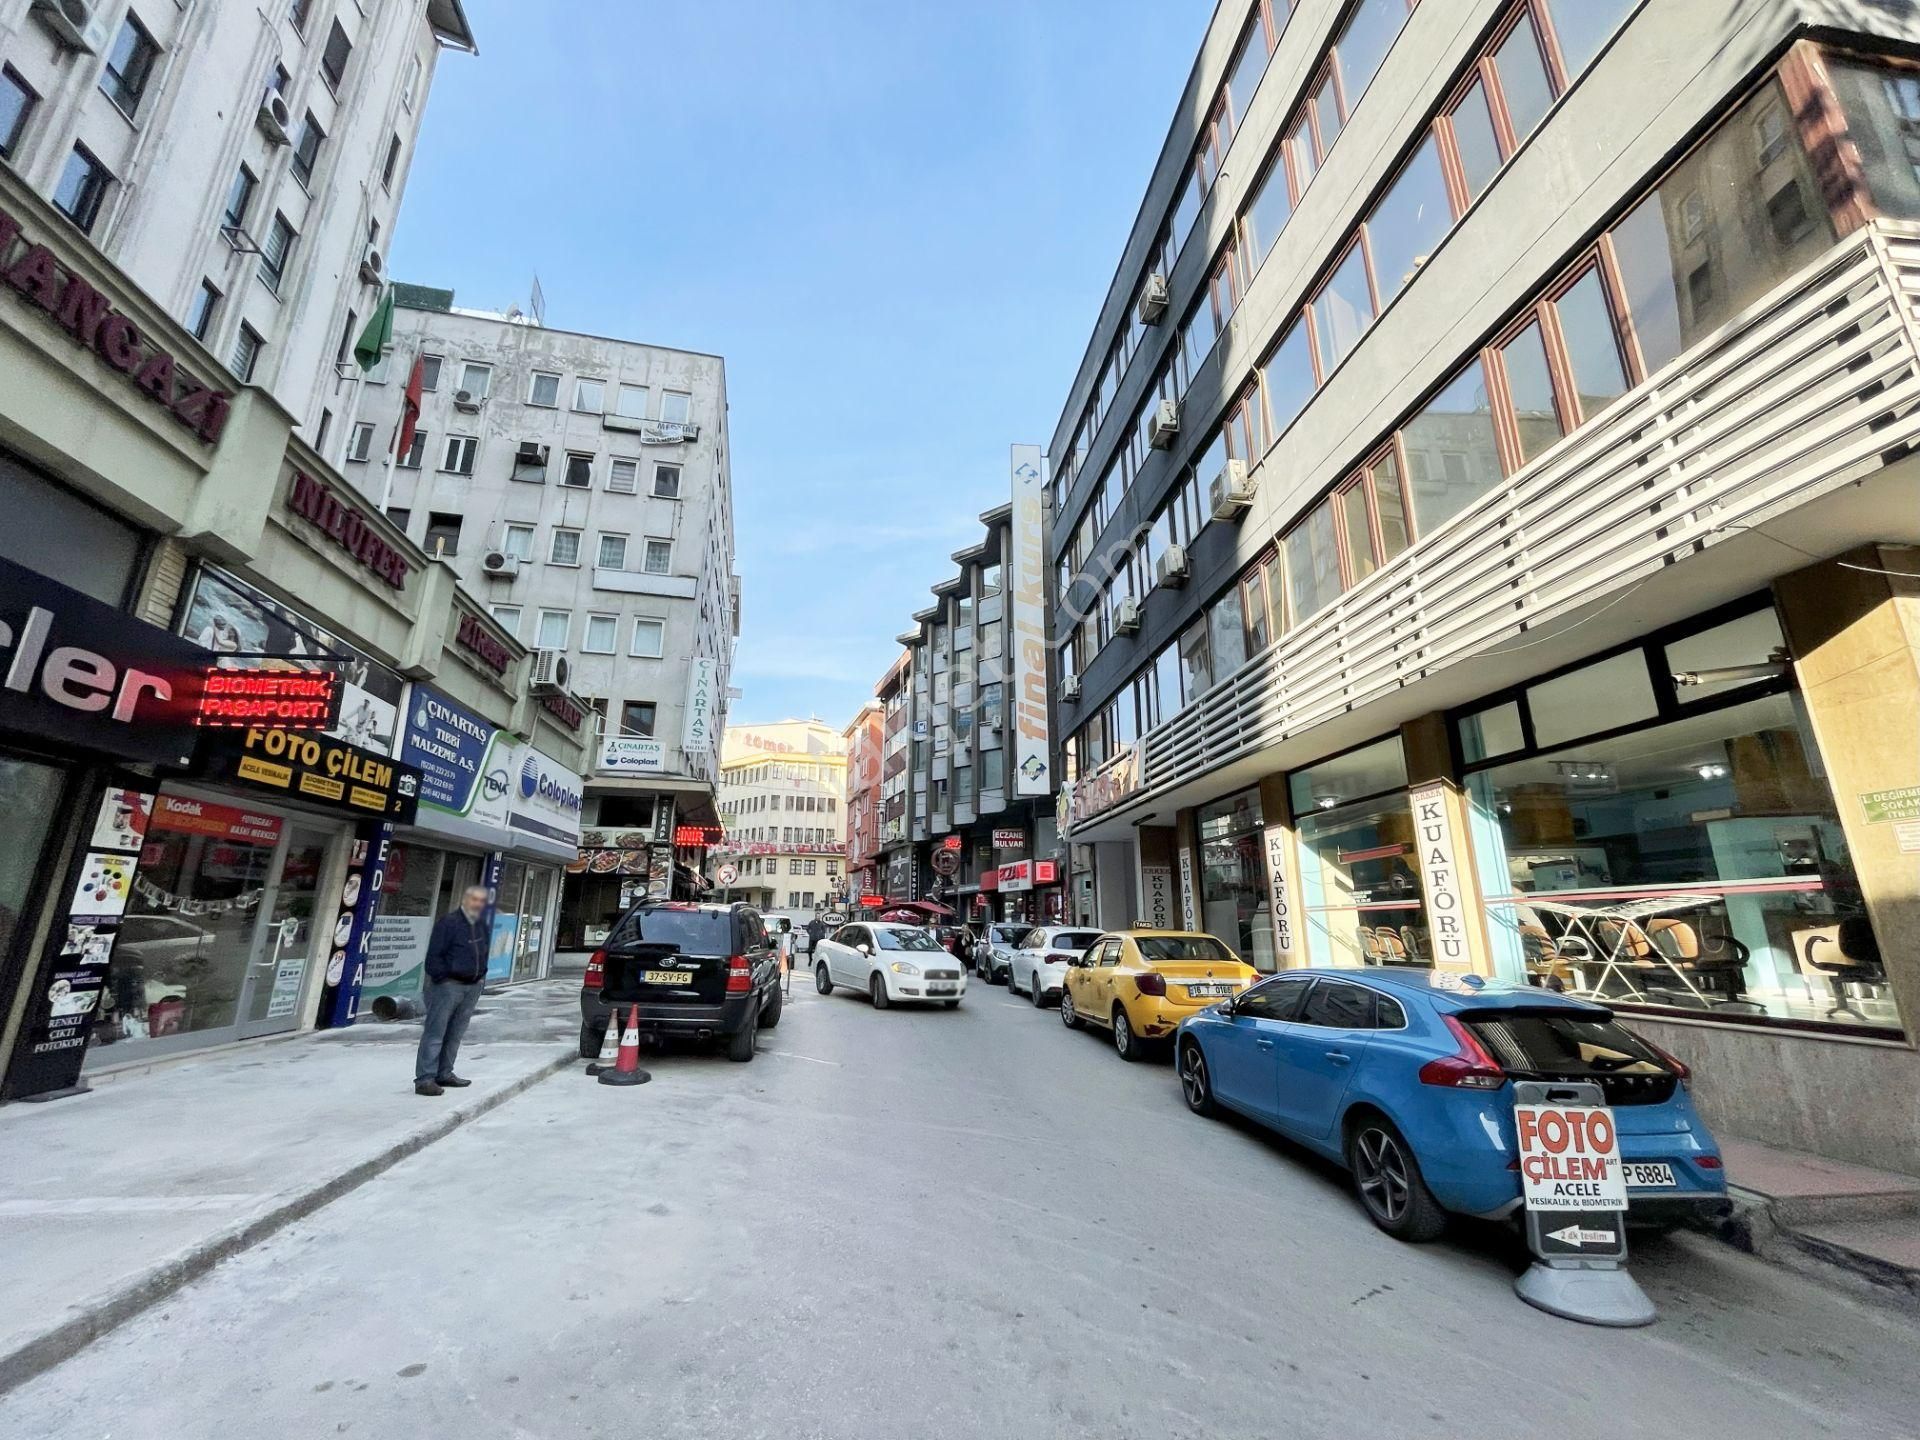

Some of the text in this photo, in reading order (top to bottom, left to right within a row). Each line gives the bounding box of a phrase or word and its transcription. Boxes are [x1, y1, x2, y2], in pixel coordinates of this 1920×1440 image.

[1015, 498, 1042, 604] kurs
[1016, 622, 1047, 742] final
[204, 698, 324, 718] PASAPORT
[427, 701, 487, 745] ÇINARTAŞ
[410, 734, 457, 763] MALZEME
[435, 727, 461, 748] TIBBİ
[245, 729, 393, 789] FOTO ÇİLEM
[620, 757, 658, 766] Coloplast
[484, 775, 510, 795] TENA
[166, 797, 203, 816] Kodak
[659, 806, 669, 839] KEBAP
[995, 831, 1024, 839] ECZANE
[1419, 801, 1461, 958] KUAFÖRÜ
[1152, 875, 1166, 929] KUAFÖRÜ
[1269, 838, 1291, 950] KUAFÖRÜ
[648, 972, 688, 982] 37-SV-FG
[34, 1036, 84, 1053] FOTOKOPİ
[1517, 1110, 1614, 1154] FOTO
[1523, 1151, 1618, 1186] ÇİLEM ART
[1635, 1165, 1674, 1184] 6884
[1554, 1183, 1601, 1196] ACELE
[1561, 1230, 1607, 1241] 2 dk teslim
